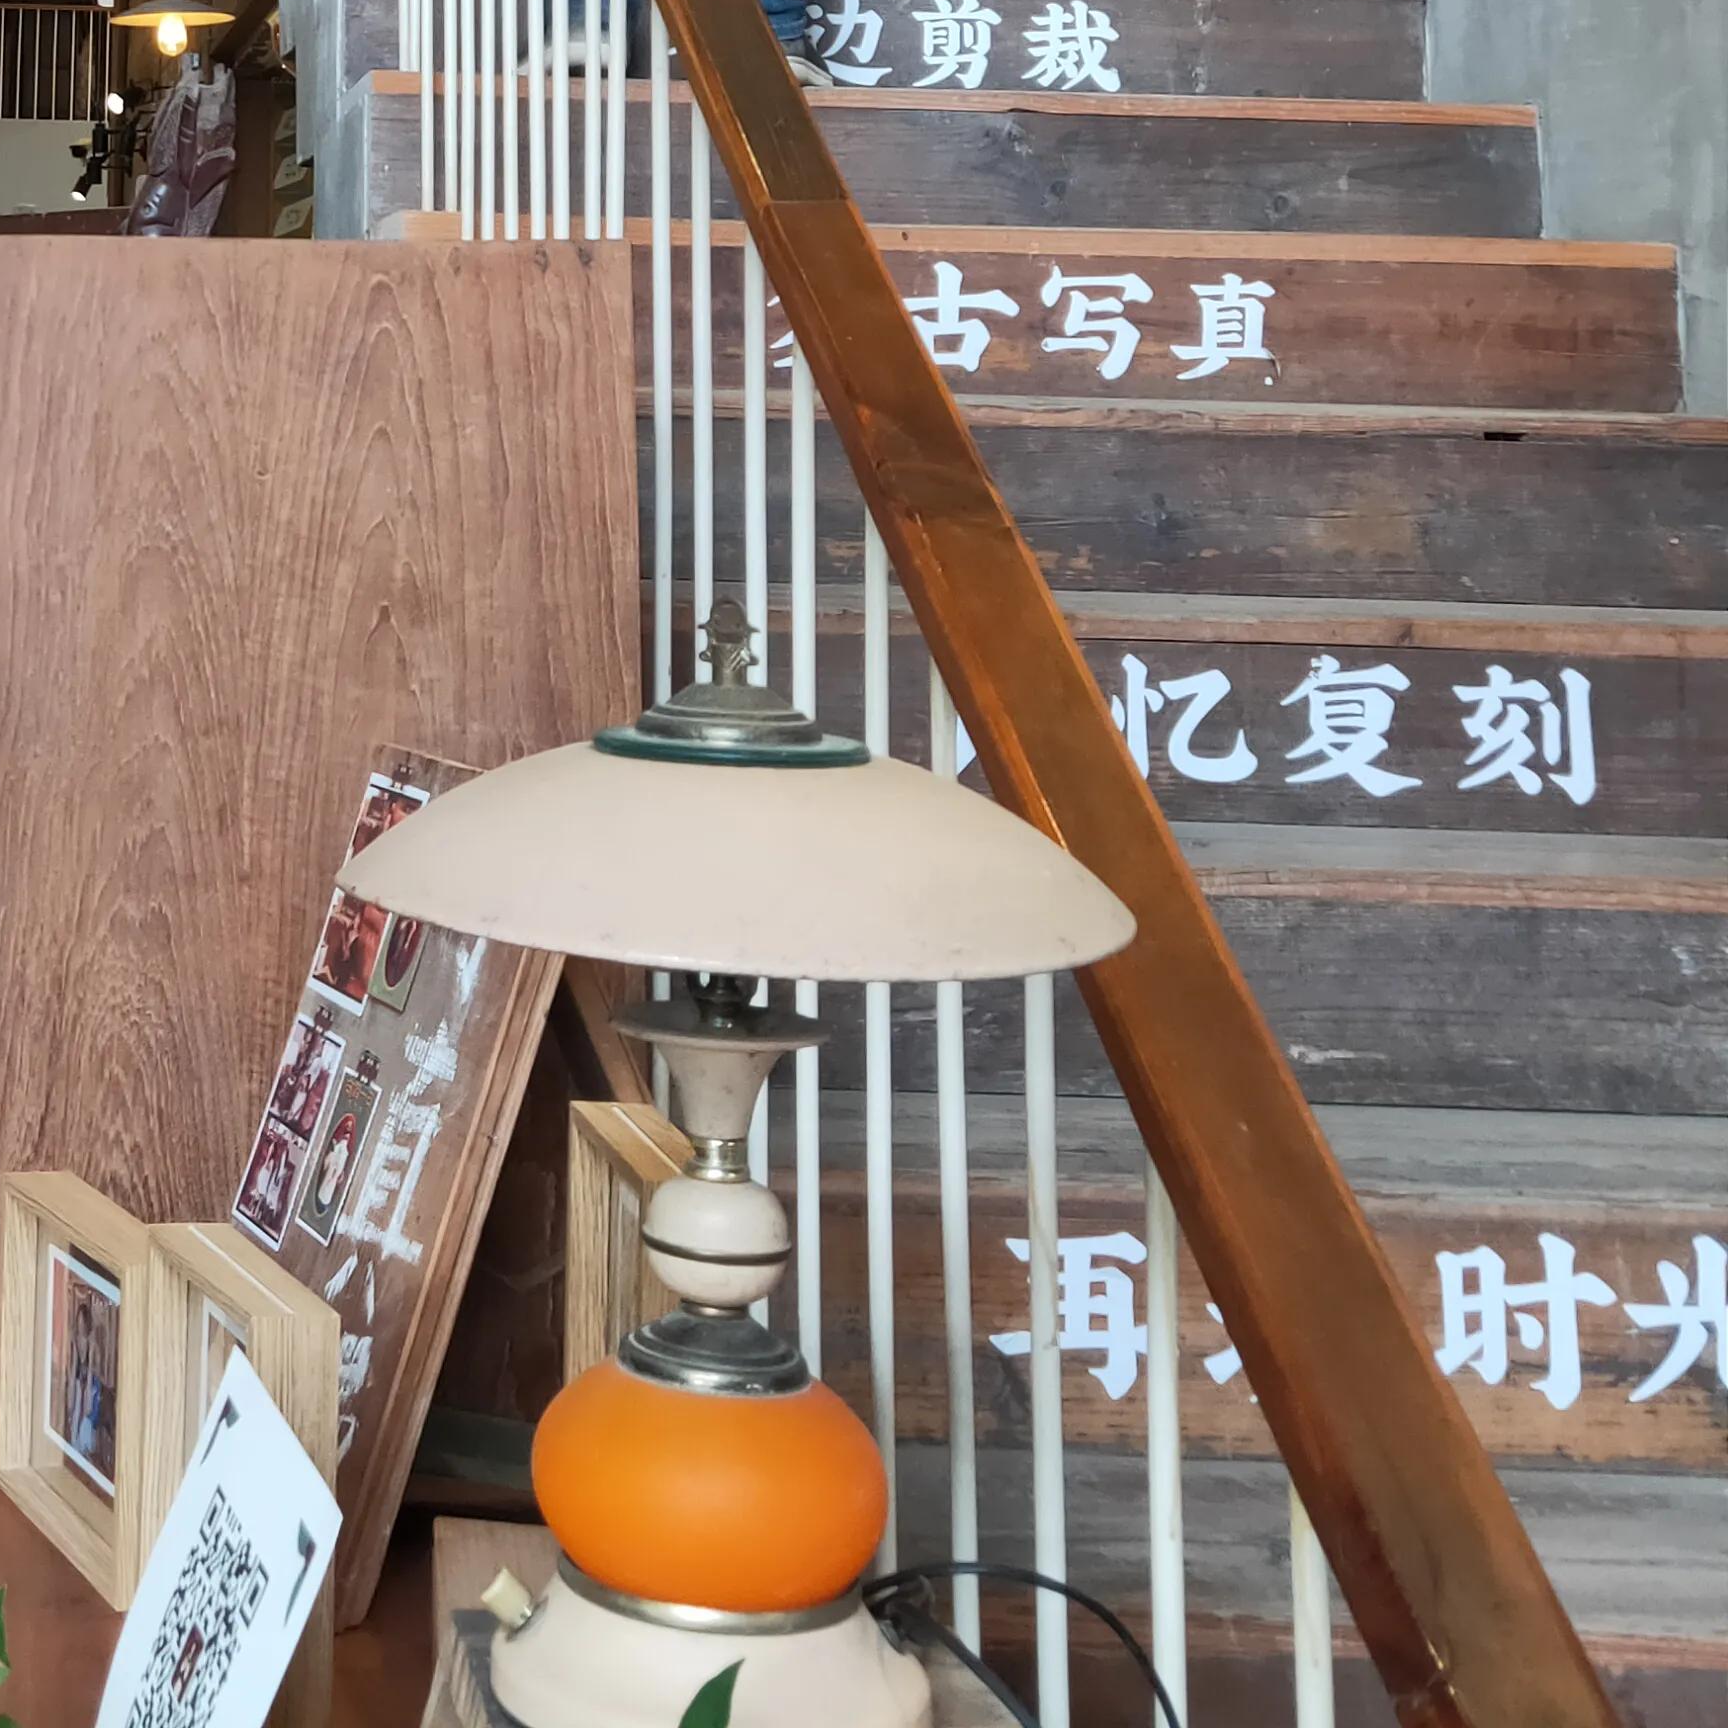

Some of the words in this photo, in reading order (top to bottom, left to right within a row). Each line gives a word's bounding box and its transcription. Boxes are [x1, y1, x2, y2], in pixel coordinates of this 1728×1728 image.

[767, 260, 1276, 386] 古写真
[957, 653, 1598, 806] 忆复刻
[988, 1230, 1728, 1412] 再时光
